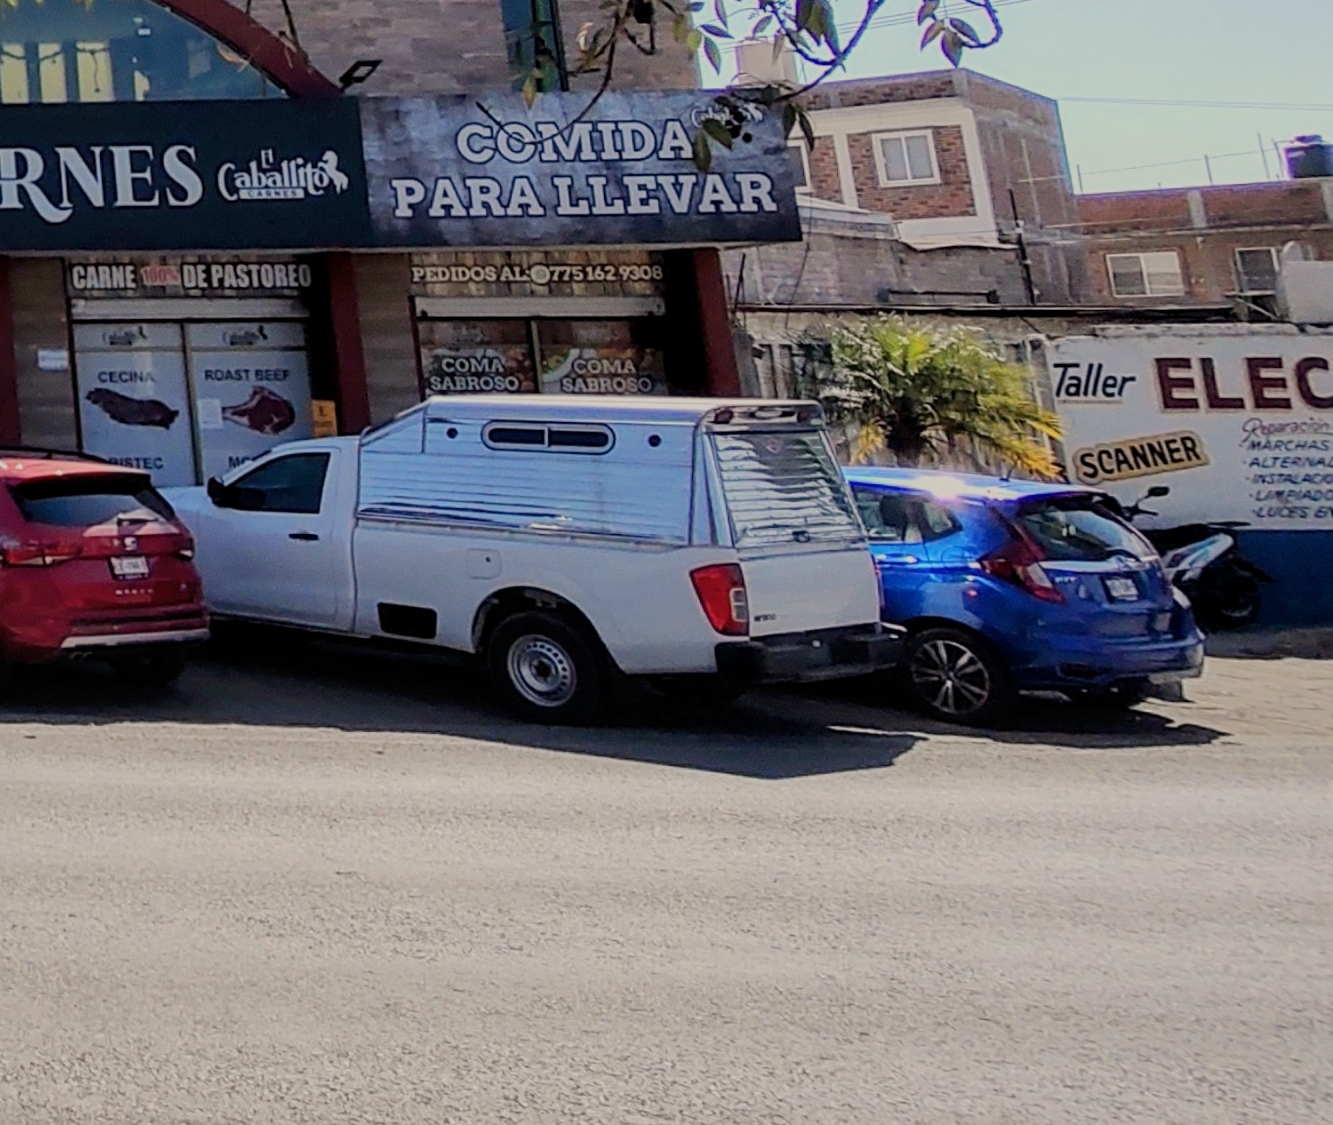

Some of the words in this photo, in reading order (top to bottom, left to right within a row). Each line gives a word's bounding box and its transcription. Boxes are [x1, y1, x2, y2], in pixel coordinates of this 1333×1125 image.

[457, 120, 693, 164] COMIDA
[218, 158, 329, 200] Caballito
[391, 177, 545, 217] PARA
[553, 172, 777, 215] LLEVAR
[72, 266, 136, 289] CARNE
[183, 265, 208, 288] DE
[211, 264, 312, 288] PASTOREO
[412, 266, 497, 282] PEDIDOS
[550, 266, 583, 281] 775
[586, 265, 617, 281] 162
[441, 358, 504, 373] COMA
[573, 359, 636, 374] COMA
[97, 371, 156, 383] CECINA
[205, 369, 250, 382] ROAST
[255, 369, 290, 381] BEEF
[431, 376, 519, 391] SABROSO
[1053, 363, 1136, 397] Taller
[1155, 357, 1333, 409] ELEC
[562, 377, 652, 392] SABROSO
[1248, 440, 1330, 451] MARCHAS
[1080, 436, 1201, 478] SCANNER
